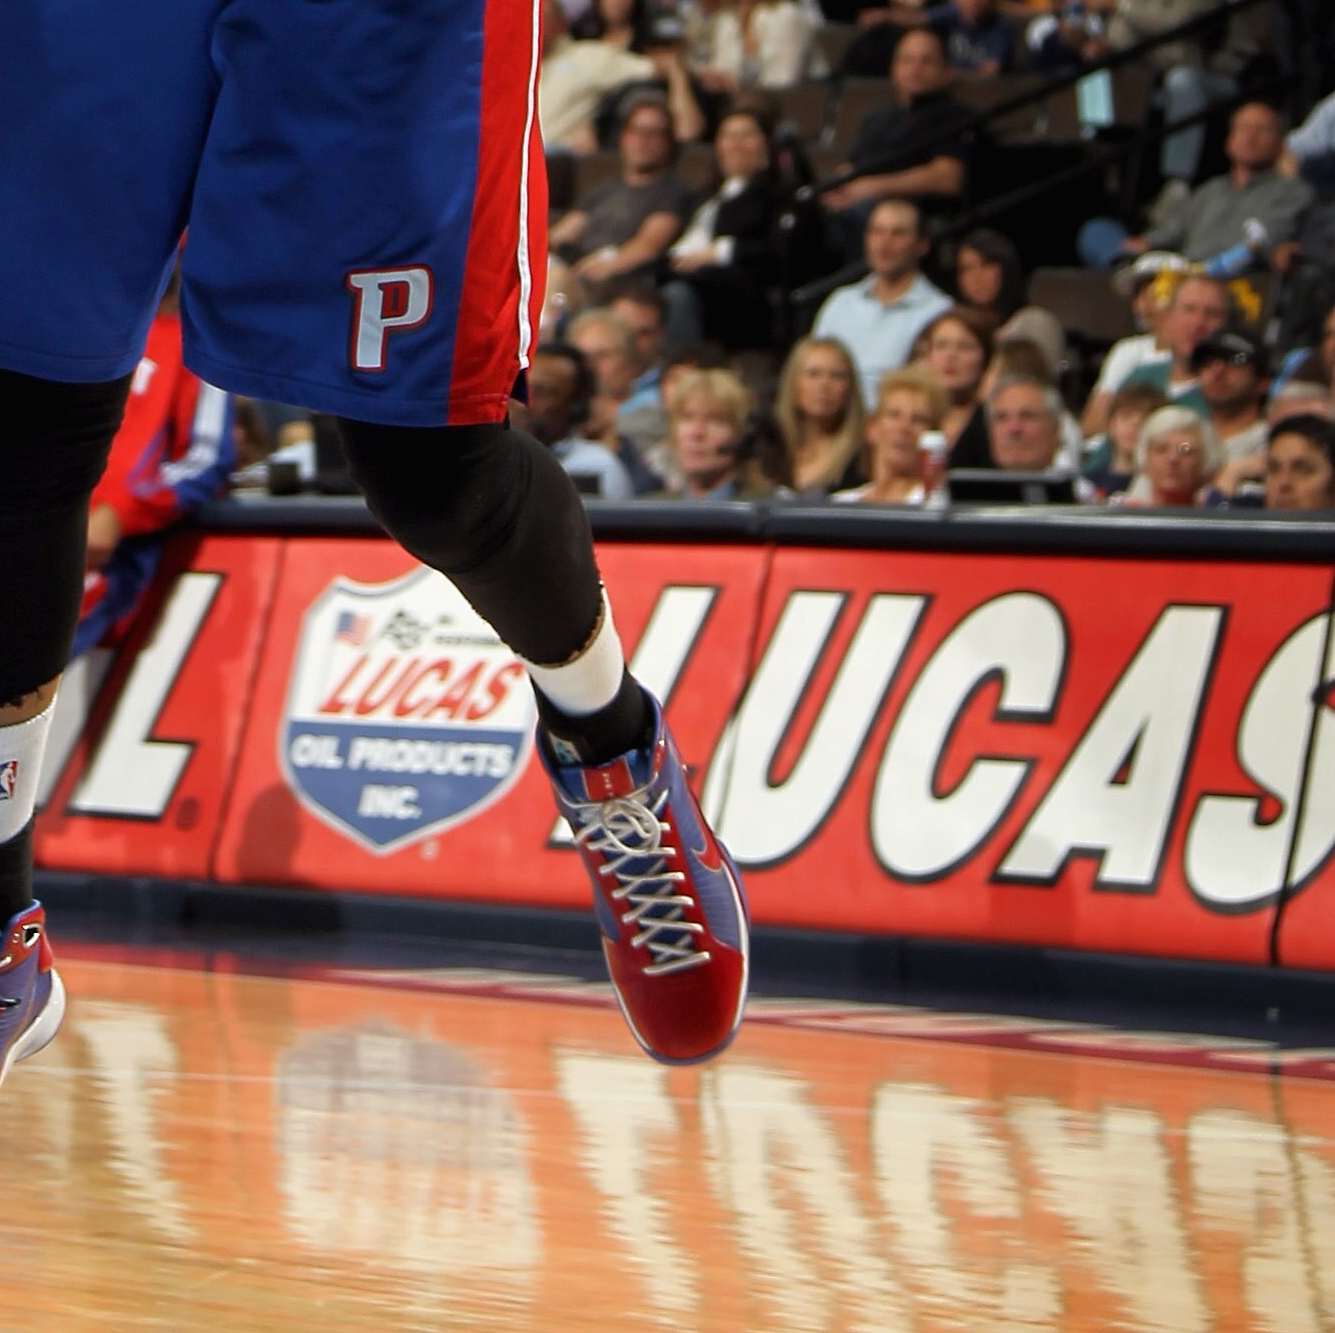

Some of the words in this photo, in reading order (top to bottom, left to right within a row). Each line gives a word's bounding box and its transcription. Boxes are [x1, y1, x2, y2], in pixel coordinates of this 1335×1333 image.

[345, 264, 434, 373] P
[317, 654, 527, 722] LUCAS
[289, 733, 344, 770] OIL
[347, 735, 515, 779] PRODUCTS
[357, 783, 422, 820] INC.
